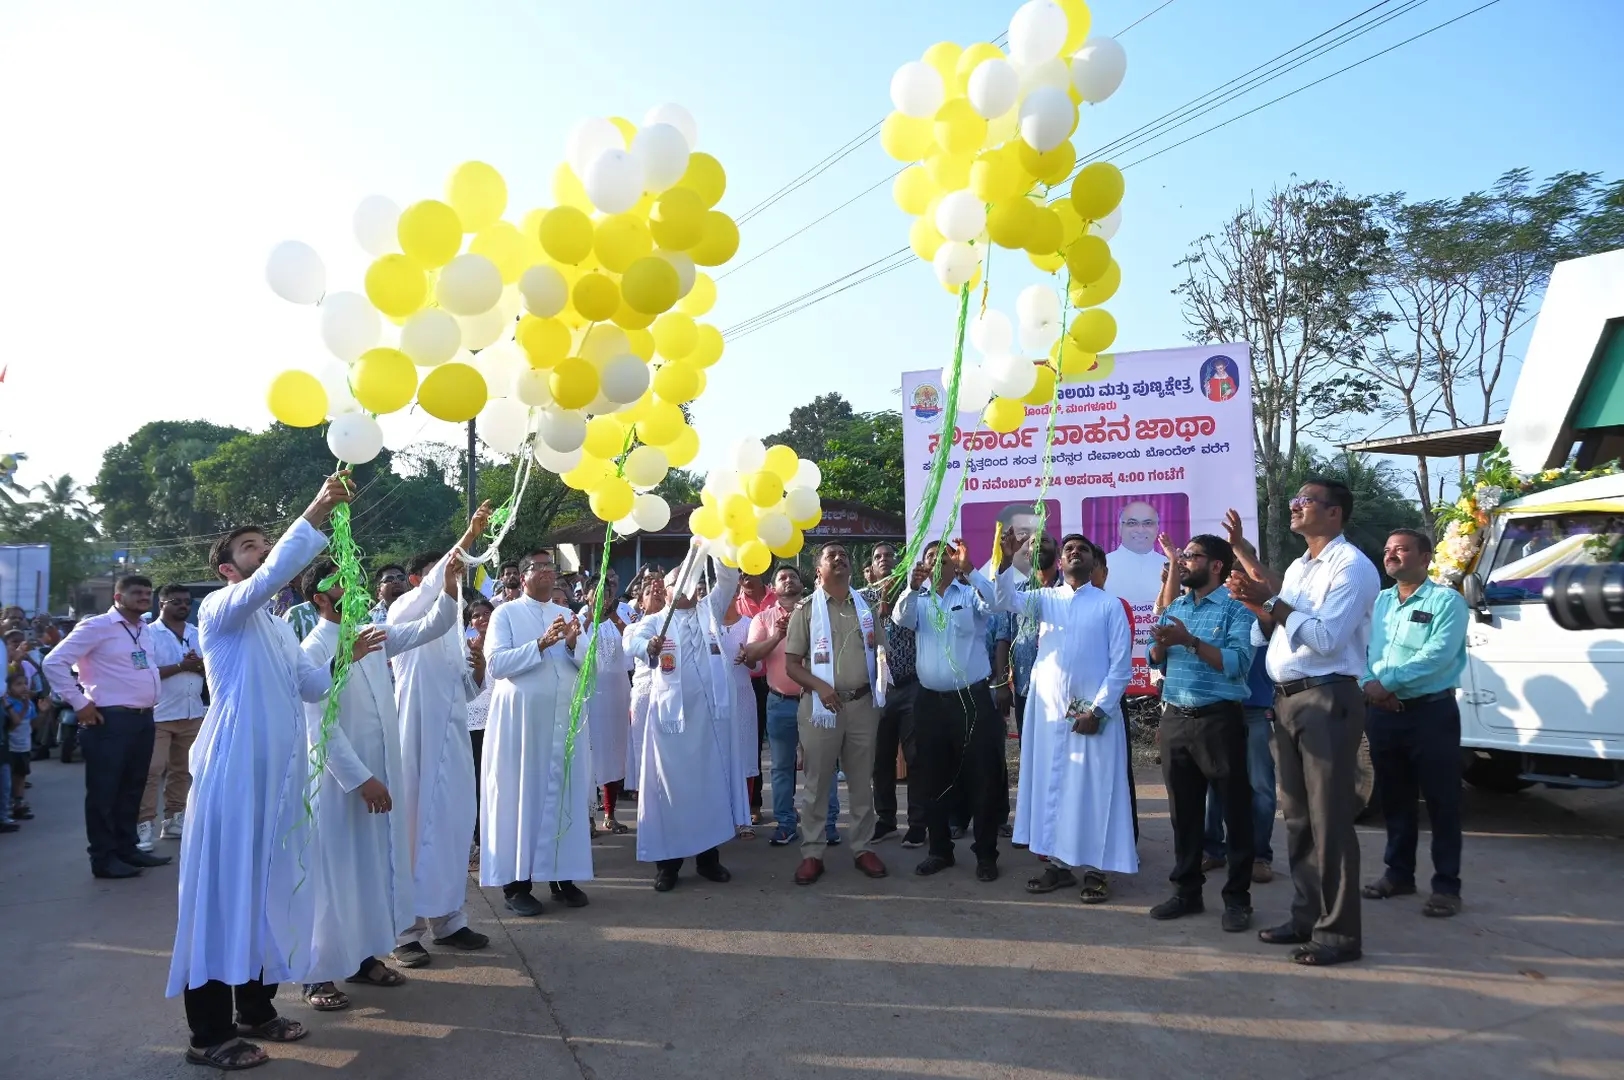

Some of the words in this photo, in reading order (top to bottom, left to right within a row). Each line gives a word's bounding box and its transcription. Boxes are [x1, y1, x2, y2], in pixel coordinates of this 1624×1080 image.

[1099, 381, 1130, 400] ಮತ್ತು
[1133, 376, 1194, 398] ಪುಣ್ಯಕ್ಷೇತ್ರ
[1066, 401, 1117, 413] ಮಂಗಳೂರು
[1046, 414, 1130, 446] ವಾಹನ
[1135, 416, 1216, 442] ಜಾಥಾ
[1012, 454, 1037, 466] ಸಂತ
[1087, 448, 1140, 461] ದೇವಾಲಯ
[1146, 444, 1196, 458] ಬೊಂದೆಲ್
[1201, 442, 1230, 455] ವರೆಗೆ
[964, 477, 979, 491] 10
[982, 476, 1032, 490] ನವೆಂಬರ್
[1065, 471, 1116, 488] ಅಪರಾಹ್ನ
[1118, 471, 1144, 483] 4:00
[1148, 466, 1185, 481] ಗಂಟೆಗೆ
